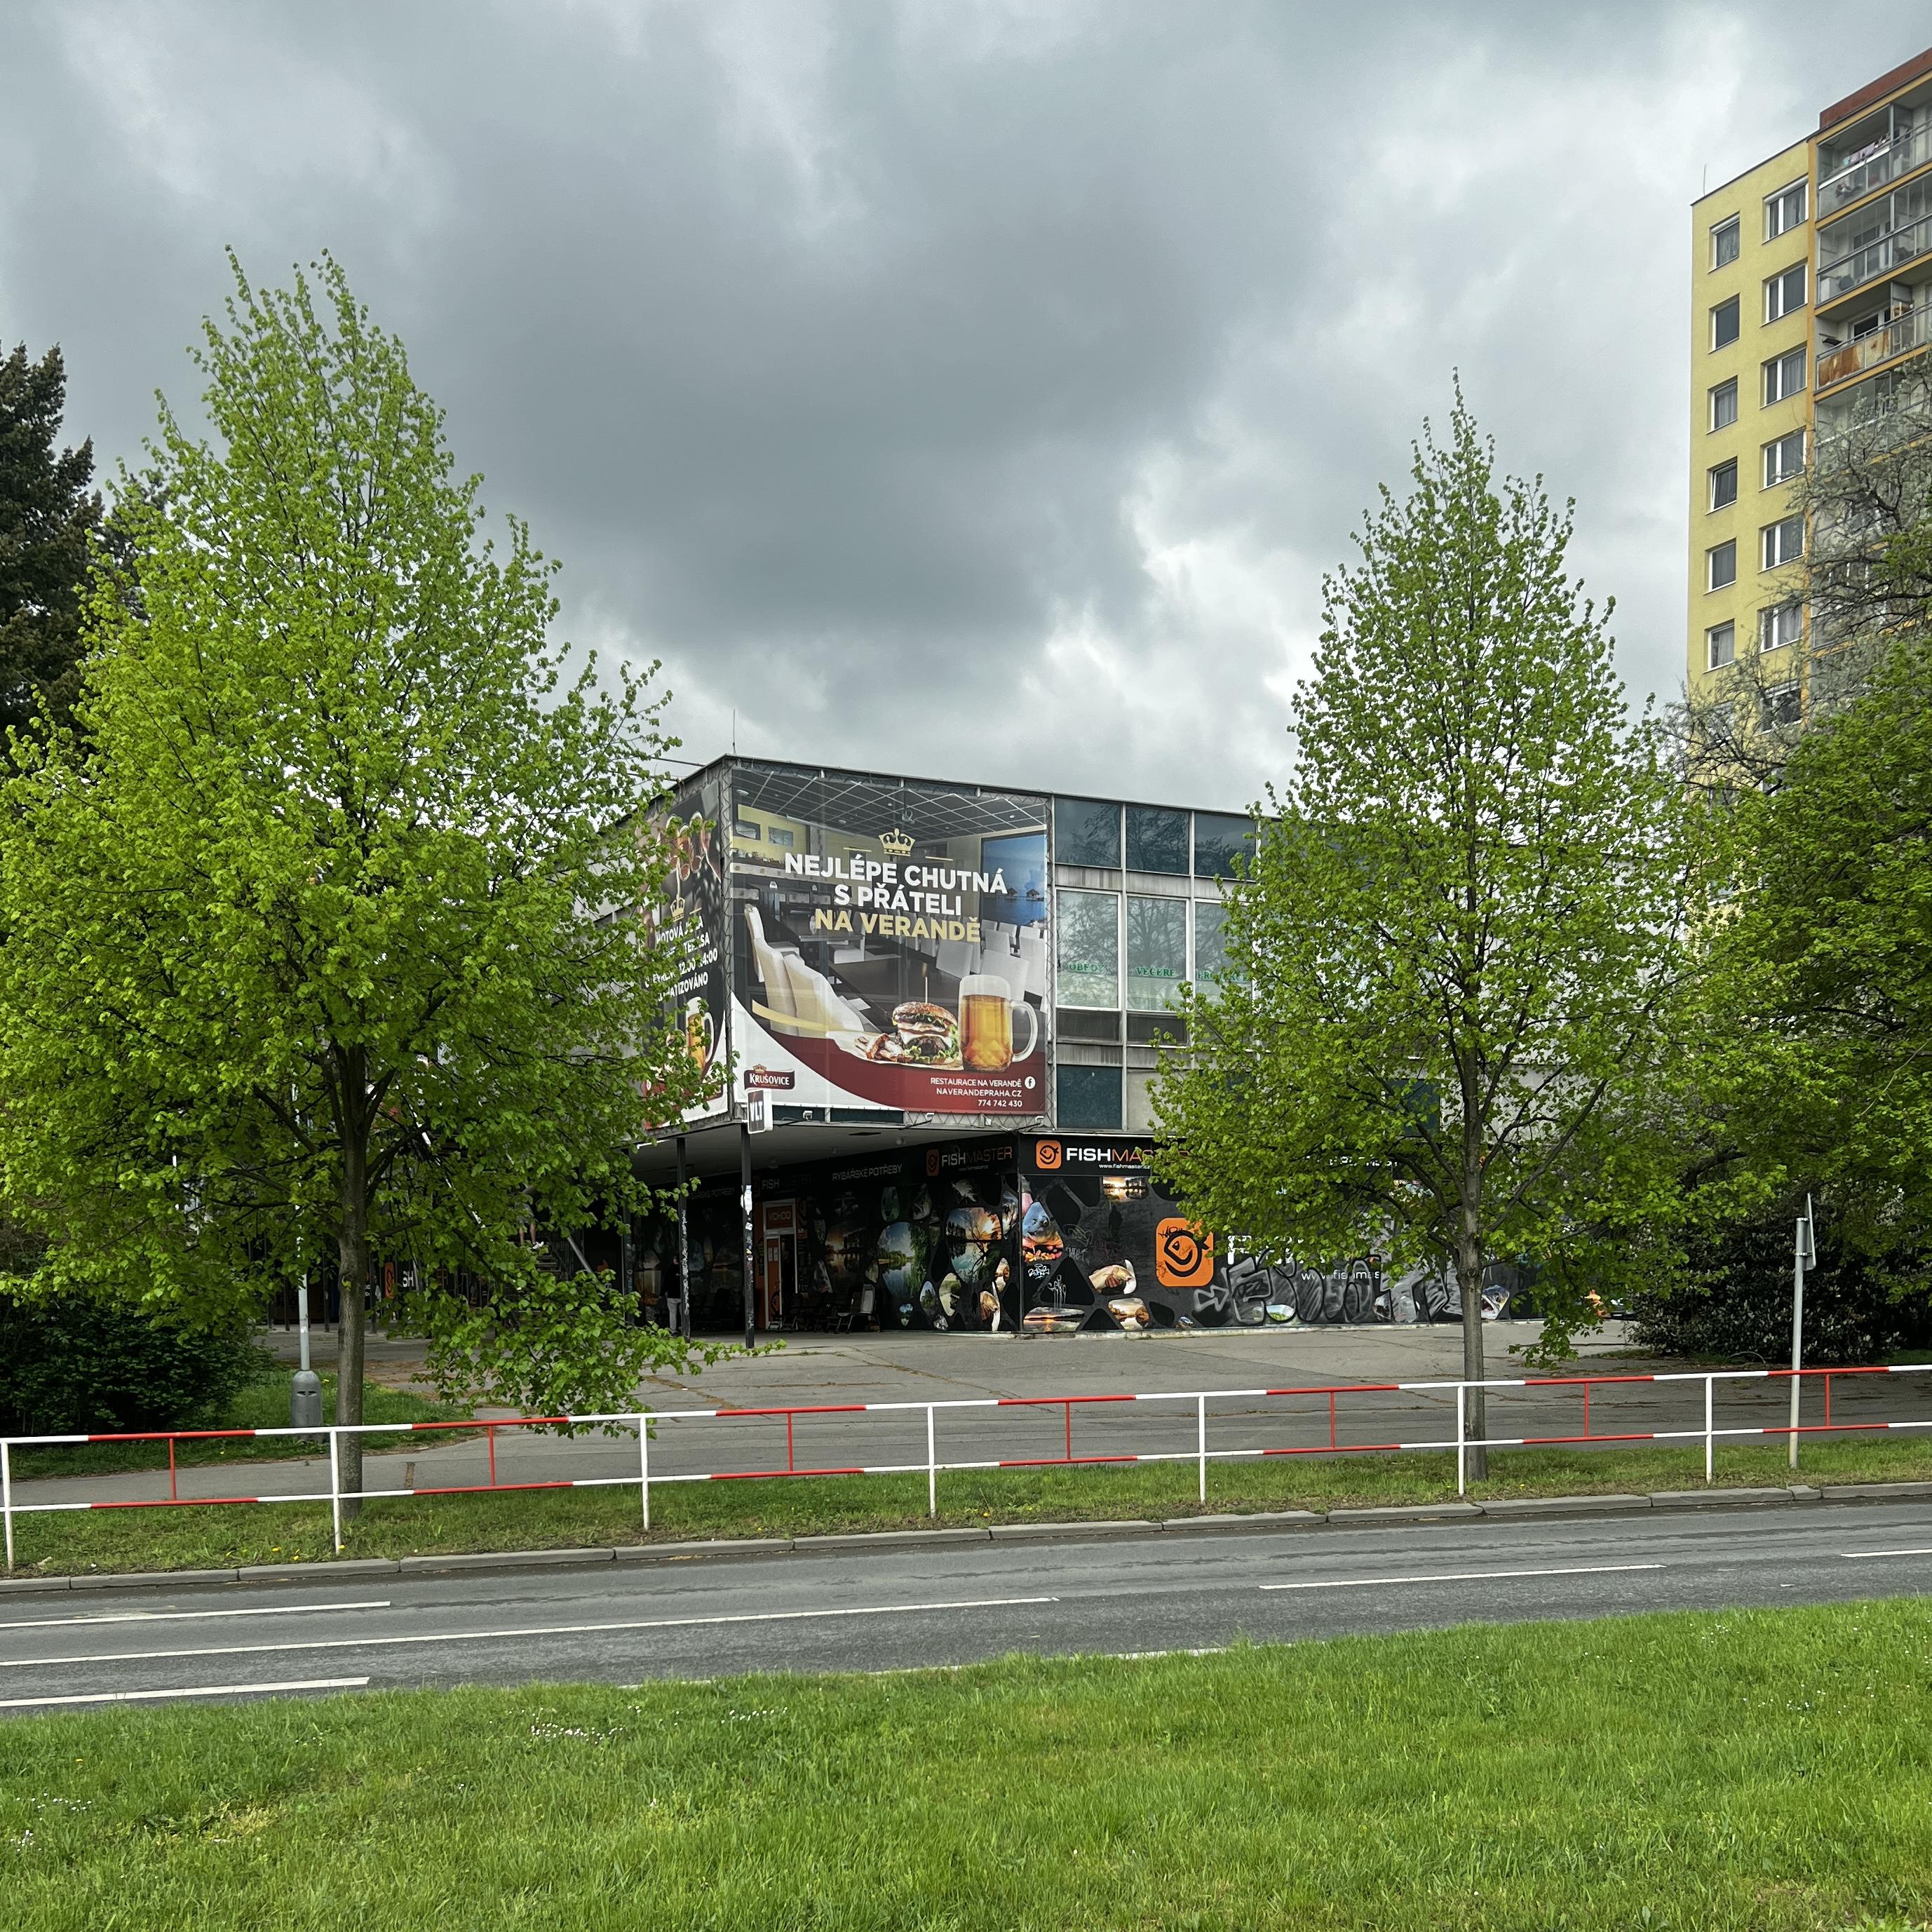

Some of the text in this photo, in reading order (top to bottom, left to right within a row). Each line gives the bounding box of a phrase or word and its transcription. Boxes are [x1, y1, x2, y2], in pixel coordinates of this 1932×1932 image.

[785, 853, 1008, 894] NEJLÉPE CHUTNÁ
[834, 882, 961, 916] S PŘÁTELI
[815, 909, 981, 943] NA VERANDĚ
[749, 1073, 790, 1086] KRUŠOVICE
[931, 1077, 976, 1086] RESTAURACE
[978, 1079, 988, 1087] NA
[989, 1079, 1022, 1087] VERANDĚ
[936, 1088, 1022, 1097] NAVERANDEPRAHA.CZ
[832, 1163, 903, 1182] RYBÁŘSKÉ POTŘEBY
[768, 1210, 791, 1221] VCHOD
